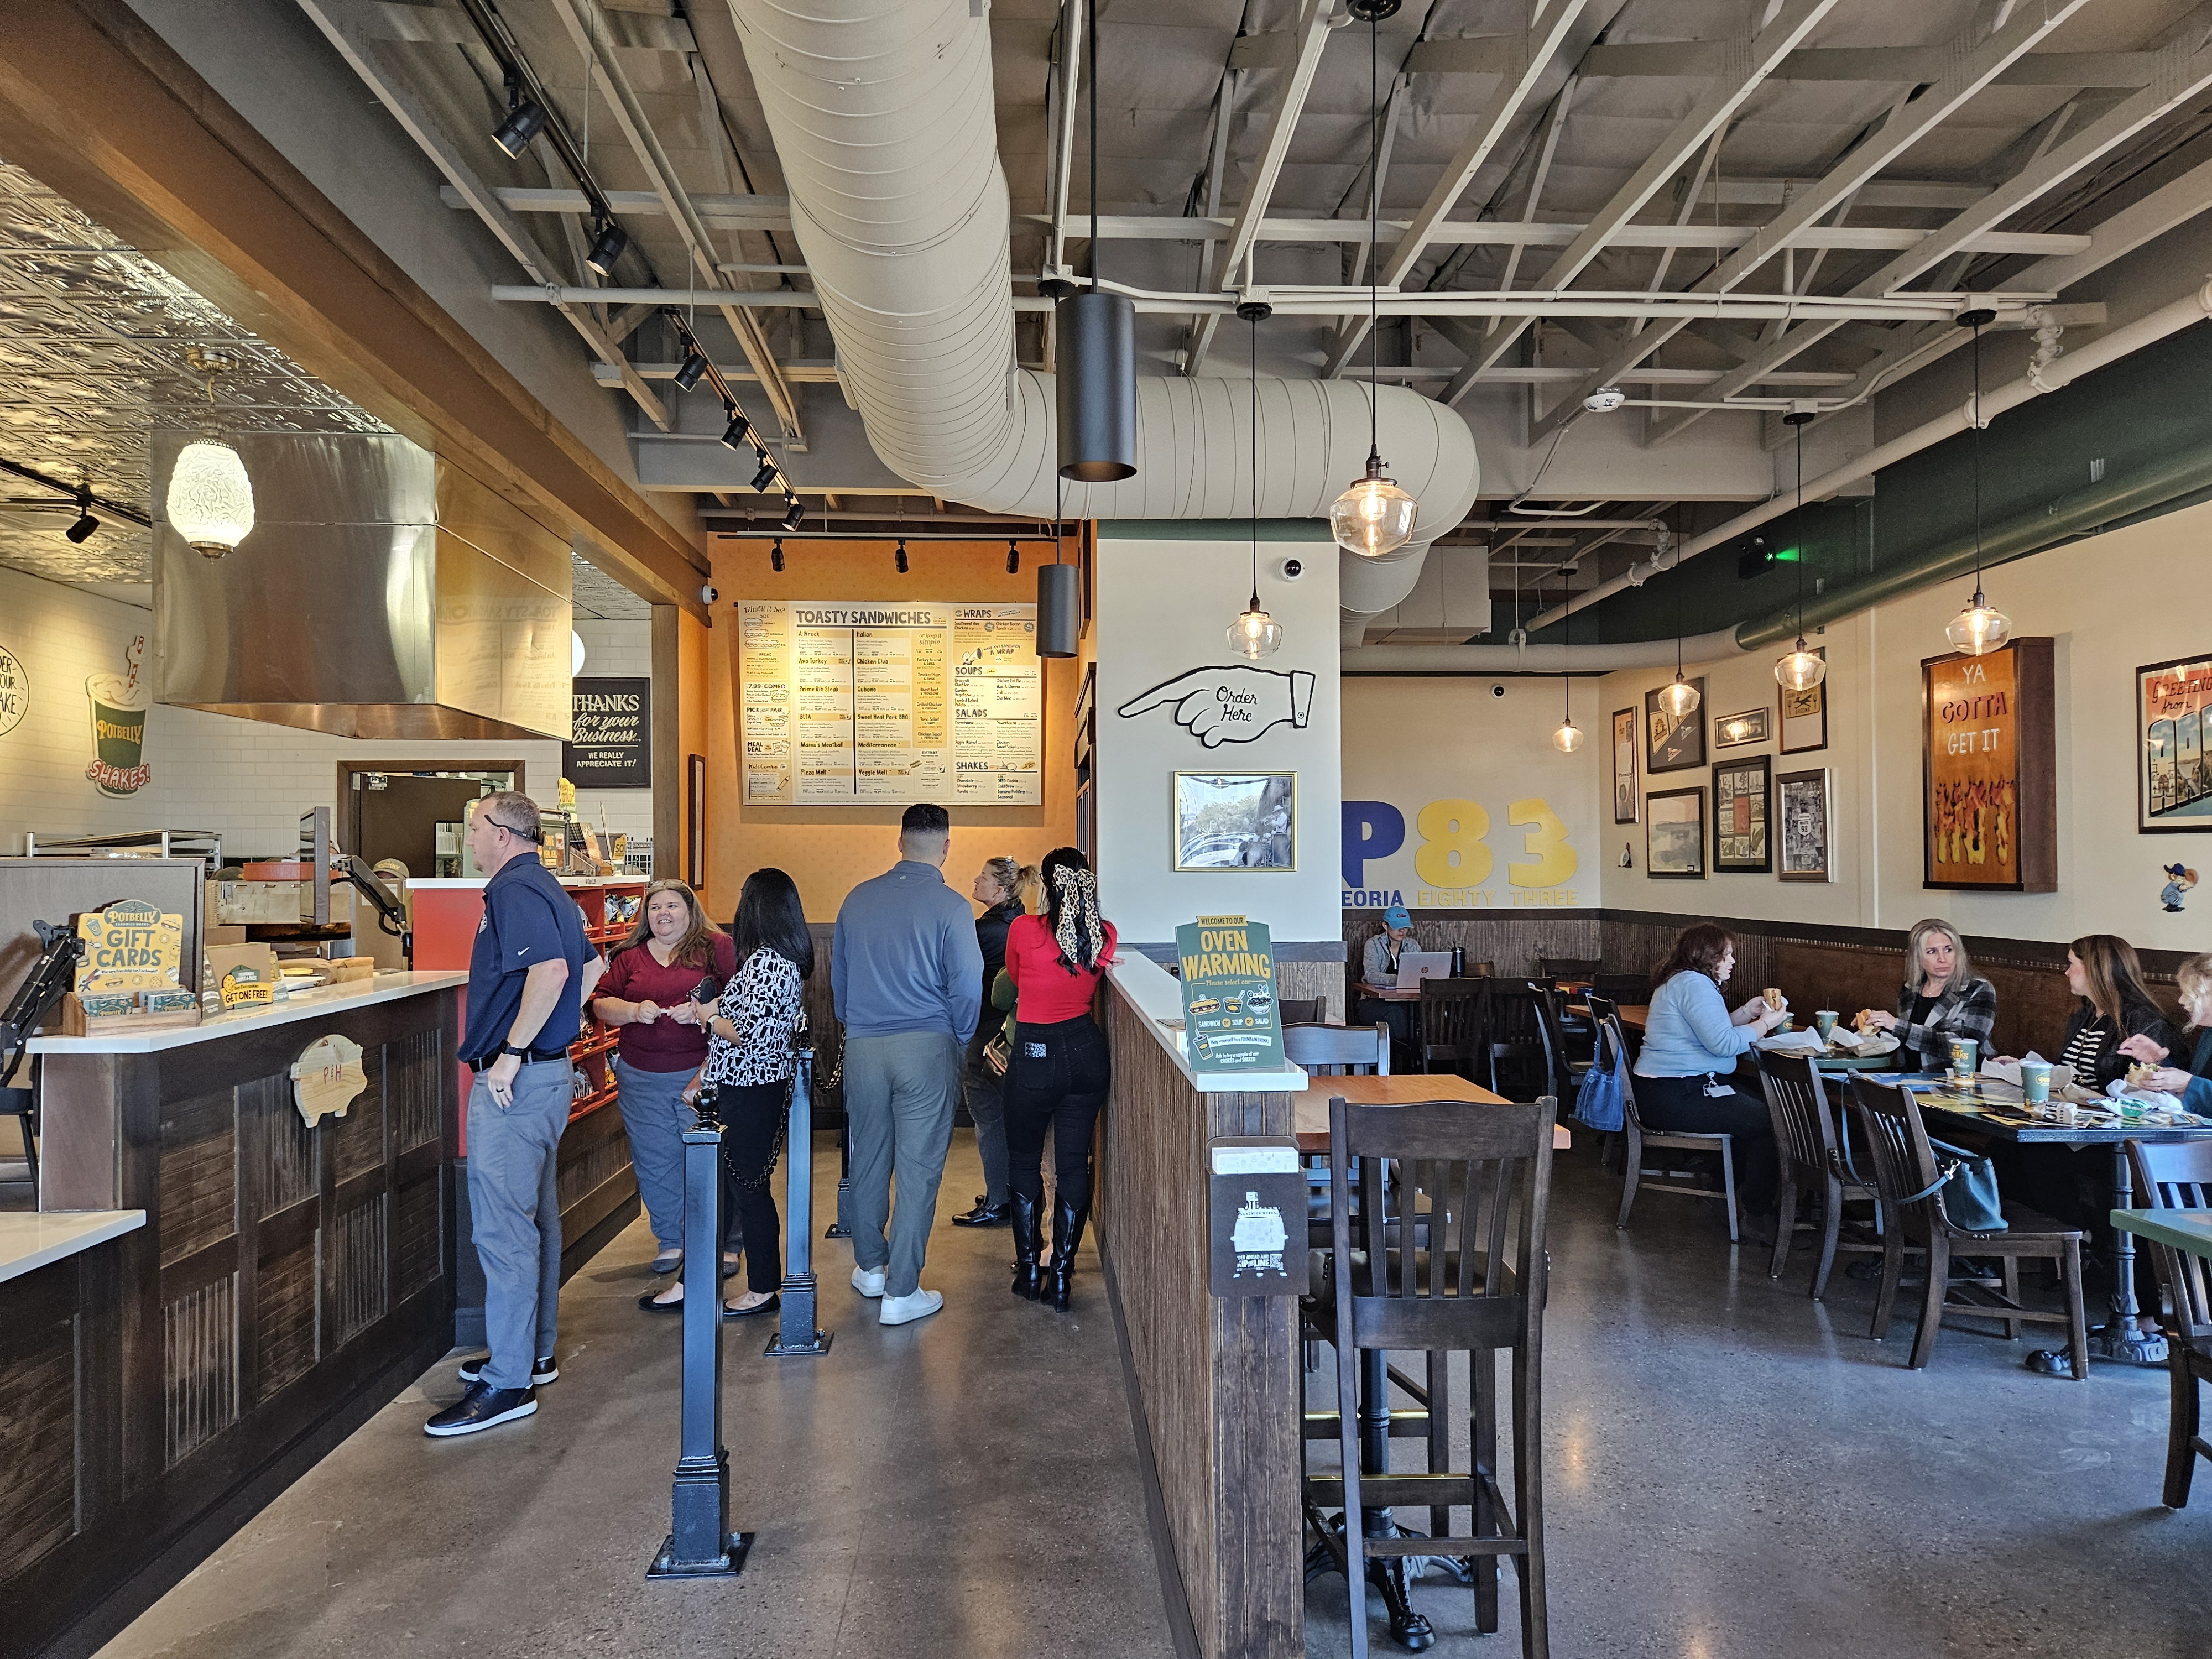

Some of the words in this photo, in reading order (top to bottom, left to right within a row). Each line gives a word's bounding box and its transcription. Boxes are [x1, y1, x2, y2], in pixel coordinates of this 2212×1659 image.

[796, 611, 848, 623] TOASTY
[851, 611, 931, 624] SANDWICHES
[964, 609, 992, 618] WRAPS
[0, 674, 17, 689] OUR
[1962, 664, 1985, 685] YA
[573, 695, 639, 712] THANKS
[1216, 686, 1258, 705] Order
[956, 709, 987, 717] SALADS
[1220, 704, 1252, 722] Here
[1942, 692, 2006, 723] GOTTA
[2161, 699, 2192, 714] from
[573, 712, 601, 729] for
[598, 715, 639, 730] your
[97, 720, 142, 744] POTBELLY
[1948, 732, 1976, 755] GET
[1982, 728, 2000, 751] IT
[89, 760, 150, 789] SHAKES!
[1342, 890, 1404, 906] EORIA
[1418, 889, 1496, 906] EIGHTY
[1510, 889, 1579, 906] THREE
[108, 911, 158, 924] POTBELLY
[107, 929, 155, 947] GIFT
[1201, 930, 1248, 952] OVEN
[97, 948, 163, 967] CARDS
[1182, 953, 1271, 982] WARMING
[226, 993, 238, 1003] GET
[239, 990, 251, 1000] ONE
[253, 990, 268, 998] FREE!
